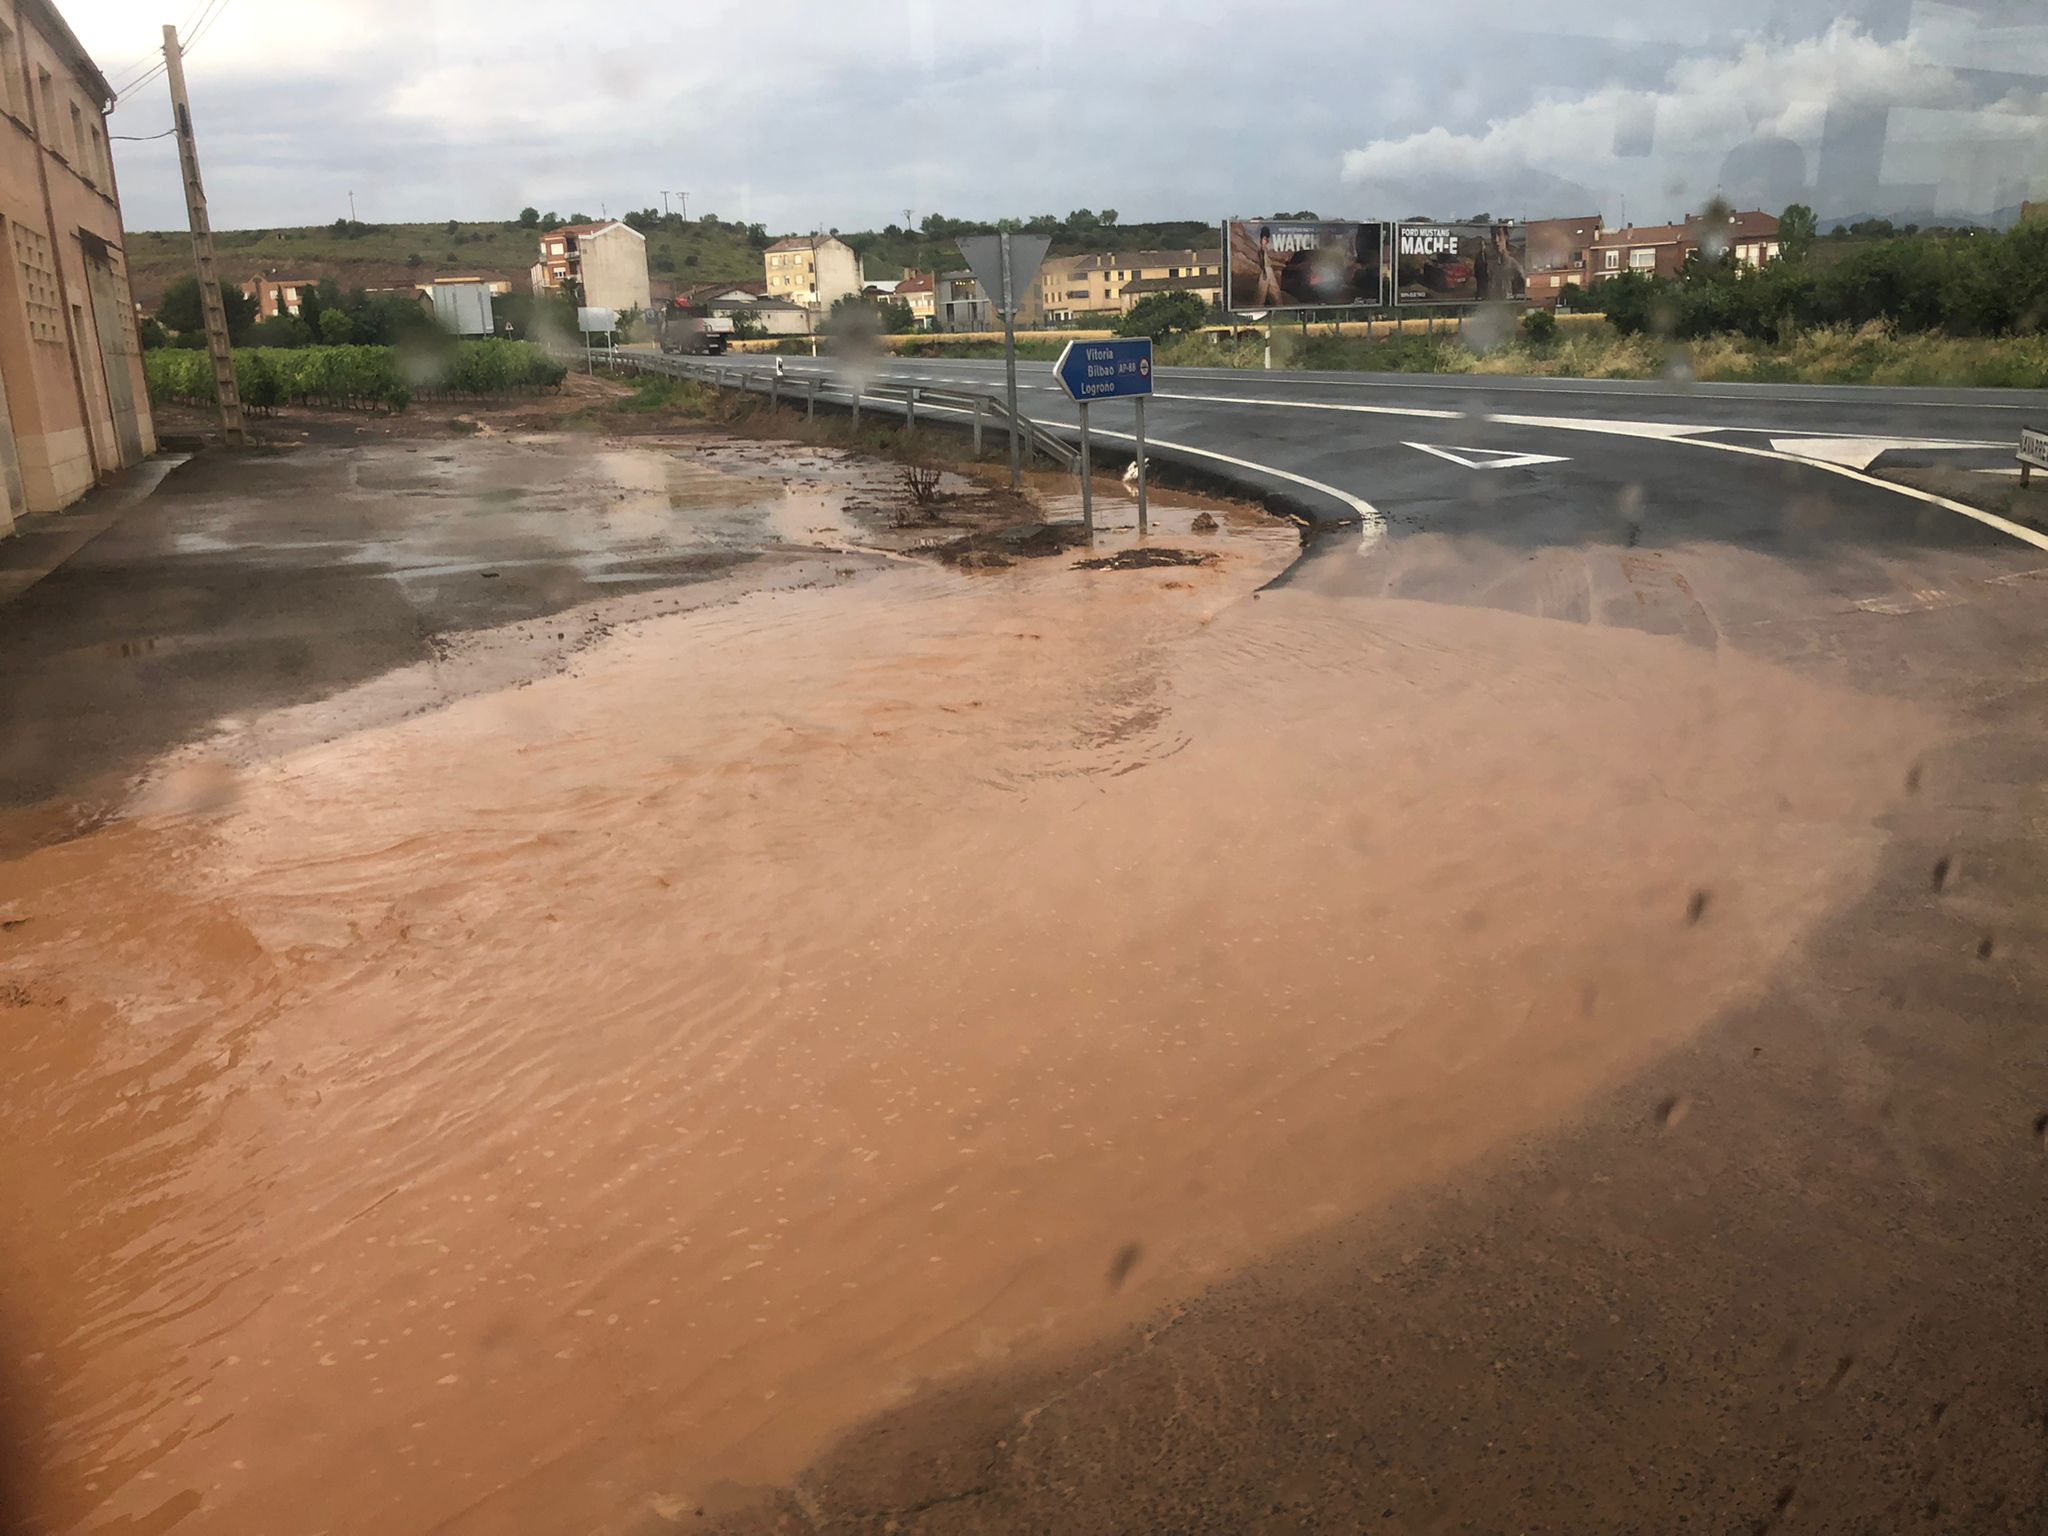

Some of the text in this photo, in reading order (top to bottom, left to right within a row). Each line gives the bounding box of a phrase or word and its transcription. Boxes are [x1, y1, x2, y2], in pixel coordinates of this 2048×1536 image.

[1401, 228, 1450, 237] FORD MUSTANG
[1272, 234, 1319, 252] WATCH
[1401, 237, 1458, 255] MACH-E
[1086, 347, 1114, 361] Vitoria
[1087, 365, 1115, 378] Bilbao
[1081, 381, 1115, 396] Logroño
